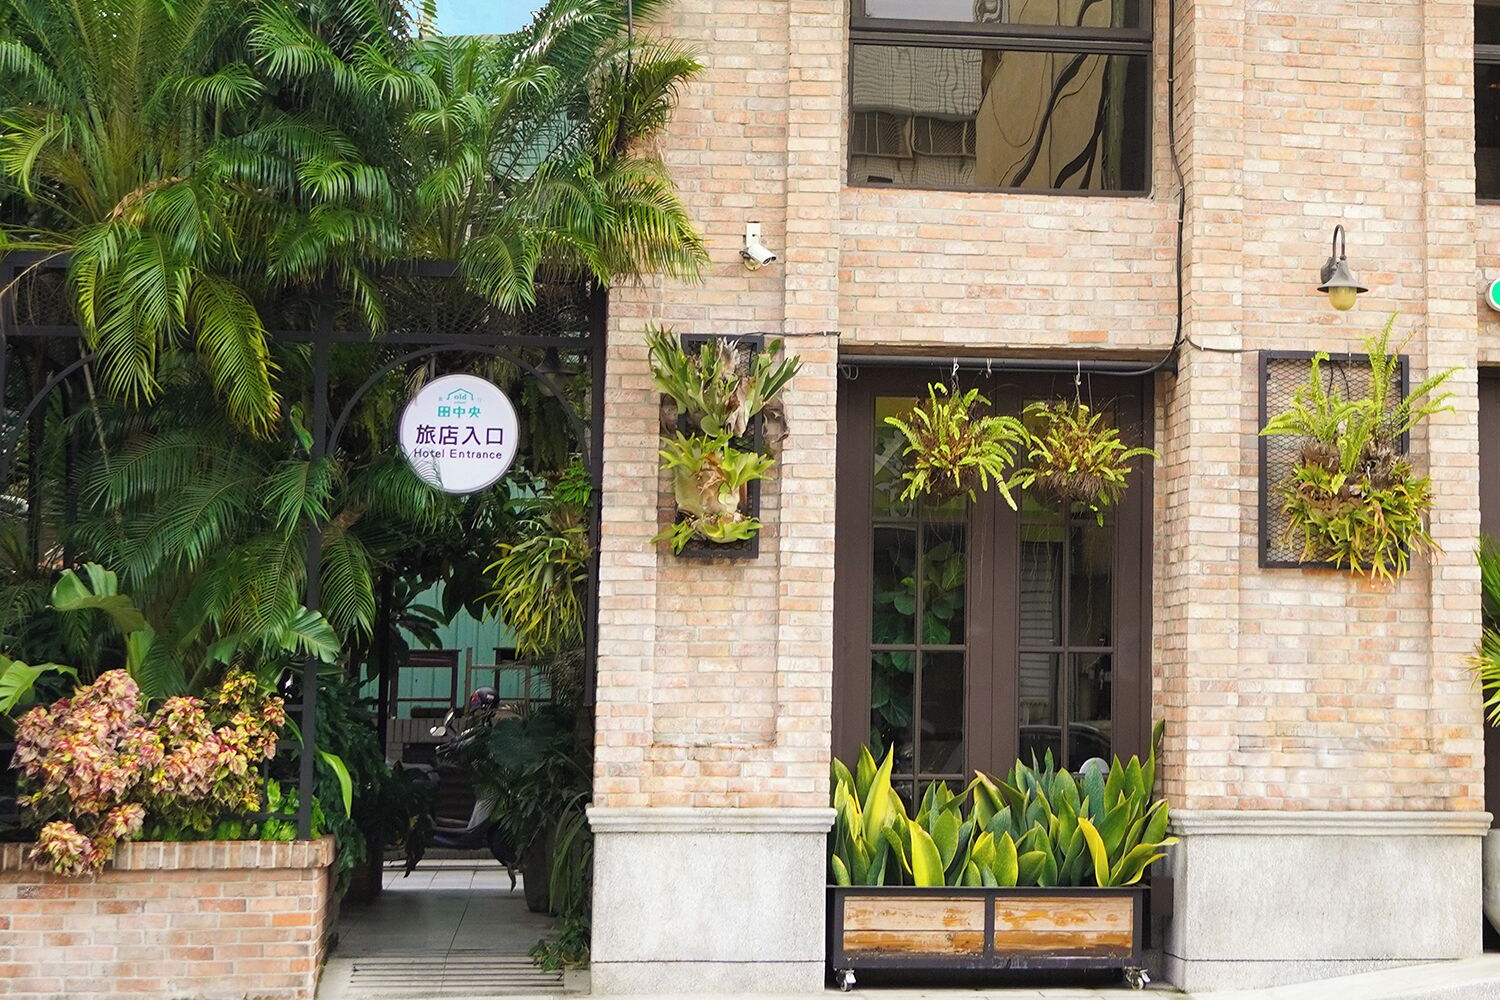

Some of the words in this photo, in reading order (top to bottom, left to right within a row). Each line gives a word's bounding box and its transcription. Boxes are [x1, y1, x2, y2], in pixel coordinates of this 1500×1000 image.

[437, 406, 481, 419] 田中央
[415, 424, 504, 446] 旅店入口
[413, 448, 446, 459] Hotel
[449, 448, 503, 460] Entrance
